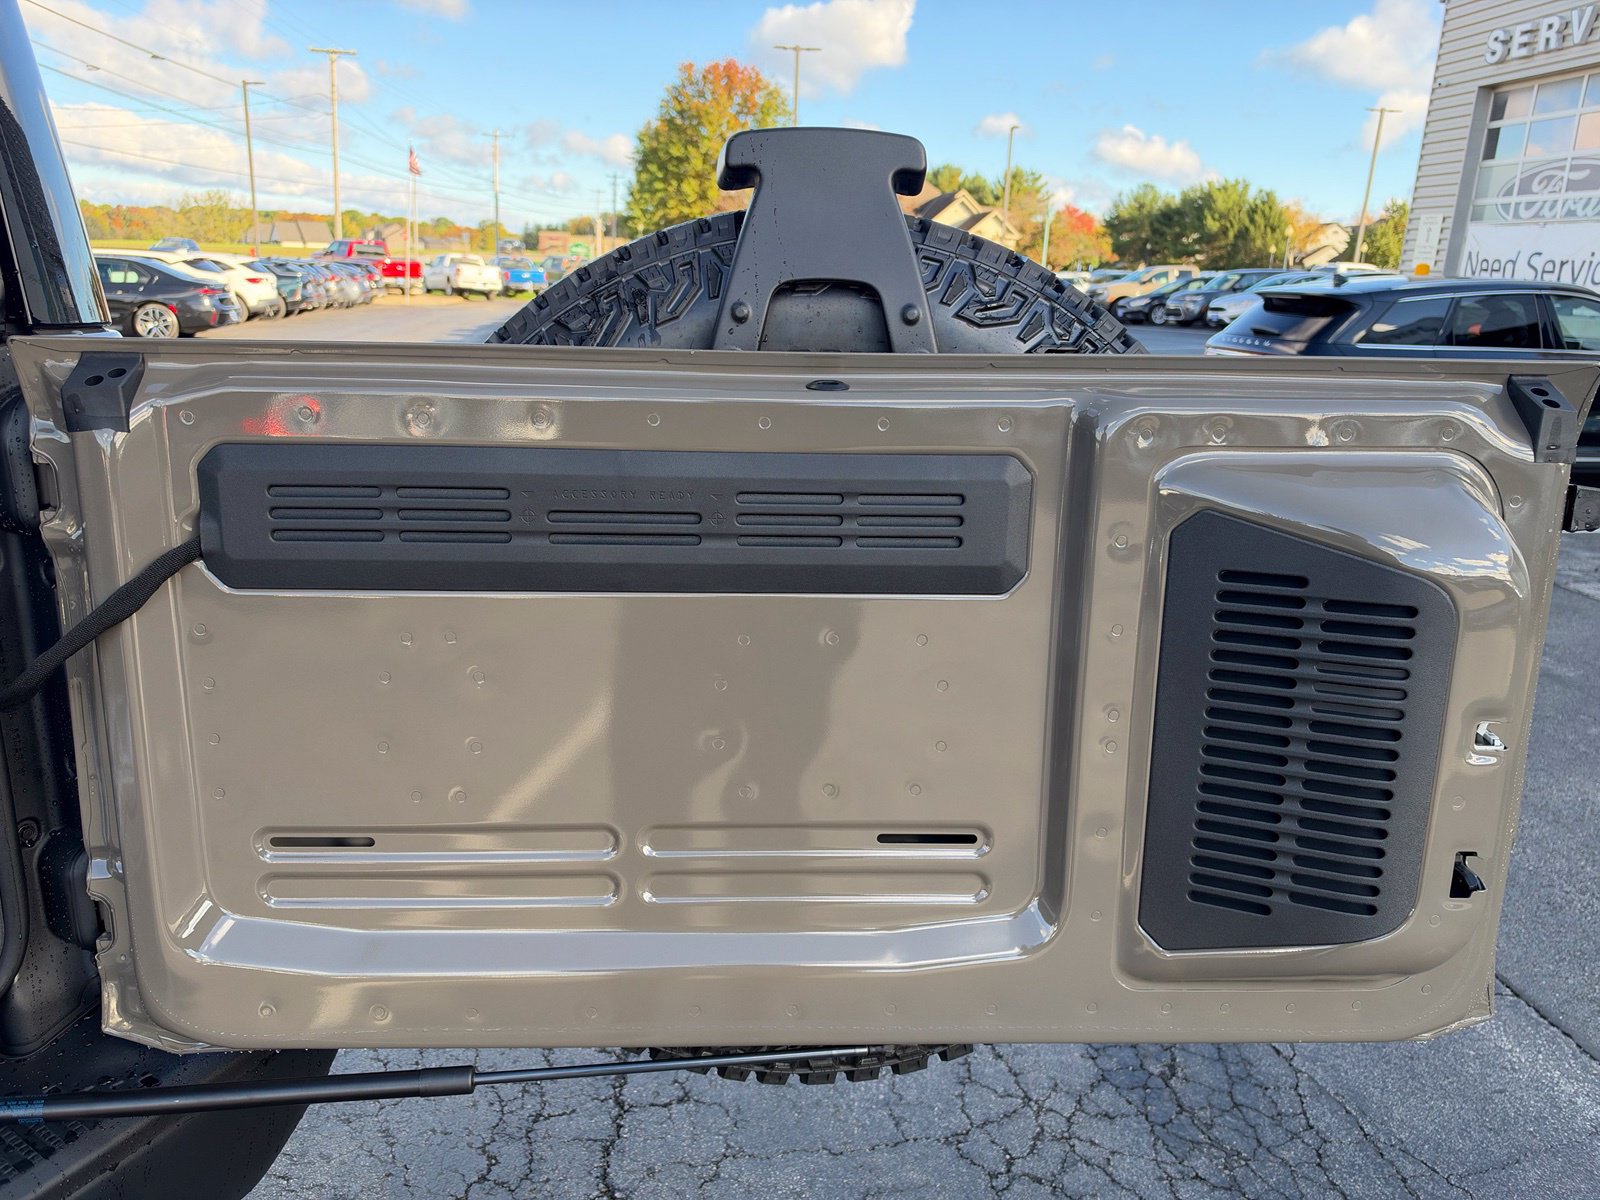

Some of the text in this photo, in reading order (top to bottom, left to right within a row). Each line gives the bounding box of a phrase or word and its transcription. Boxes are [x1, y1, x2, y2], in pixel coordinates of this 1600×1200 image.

[1485, 5, 1595, 64] SERV
[1464, 250, 1521, 278] Need
[552, 489, 696, 501] ACCESSORY READY
